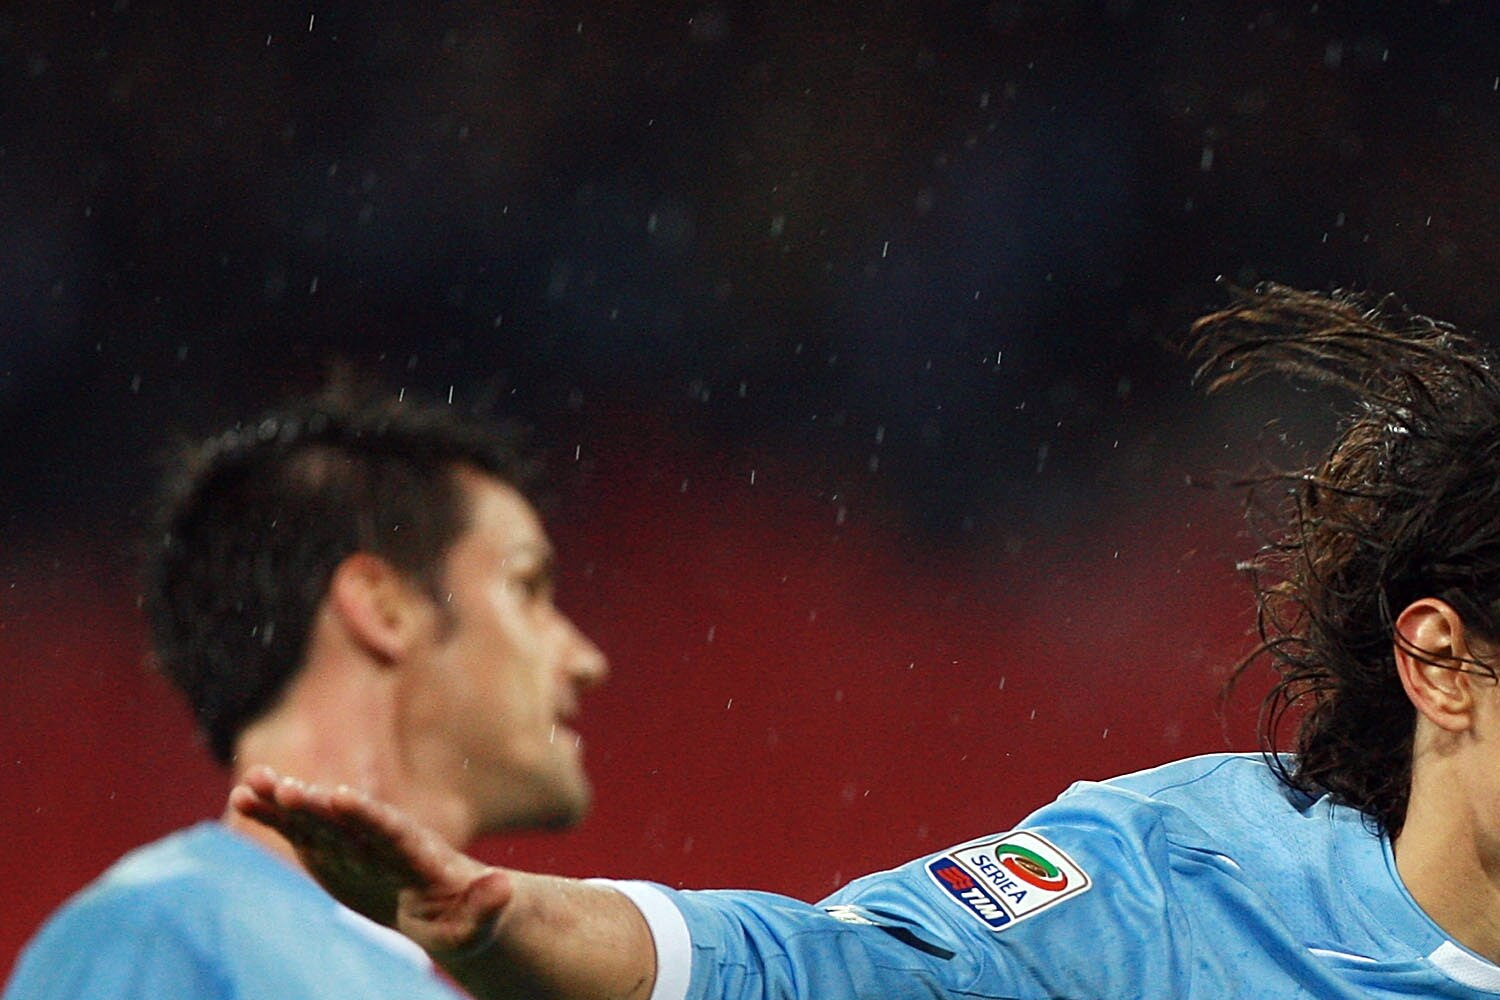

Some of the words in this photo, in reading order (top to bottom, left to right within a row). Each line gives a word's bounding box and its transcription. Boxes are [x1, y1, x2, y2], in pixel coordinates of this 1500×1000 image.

[971, 855, 1018, 894] SERIE
[1007, 890, 1027, 904] A
[960, 887, 1005, 920] TIM
